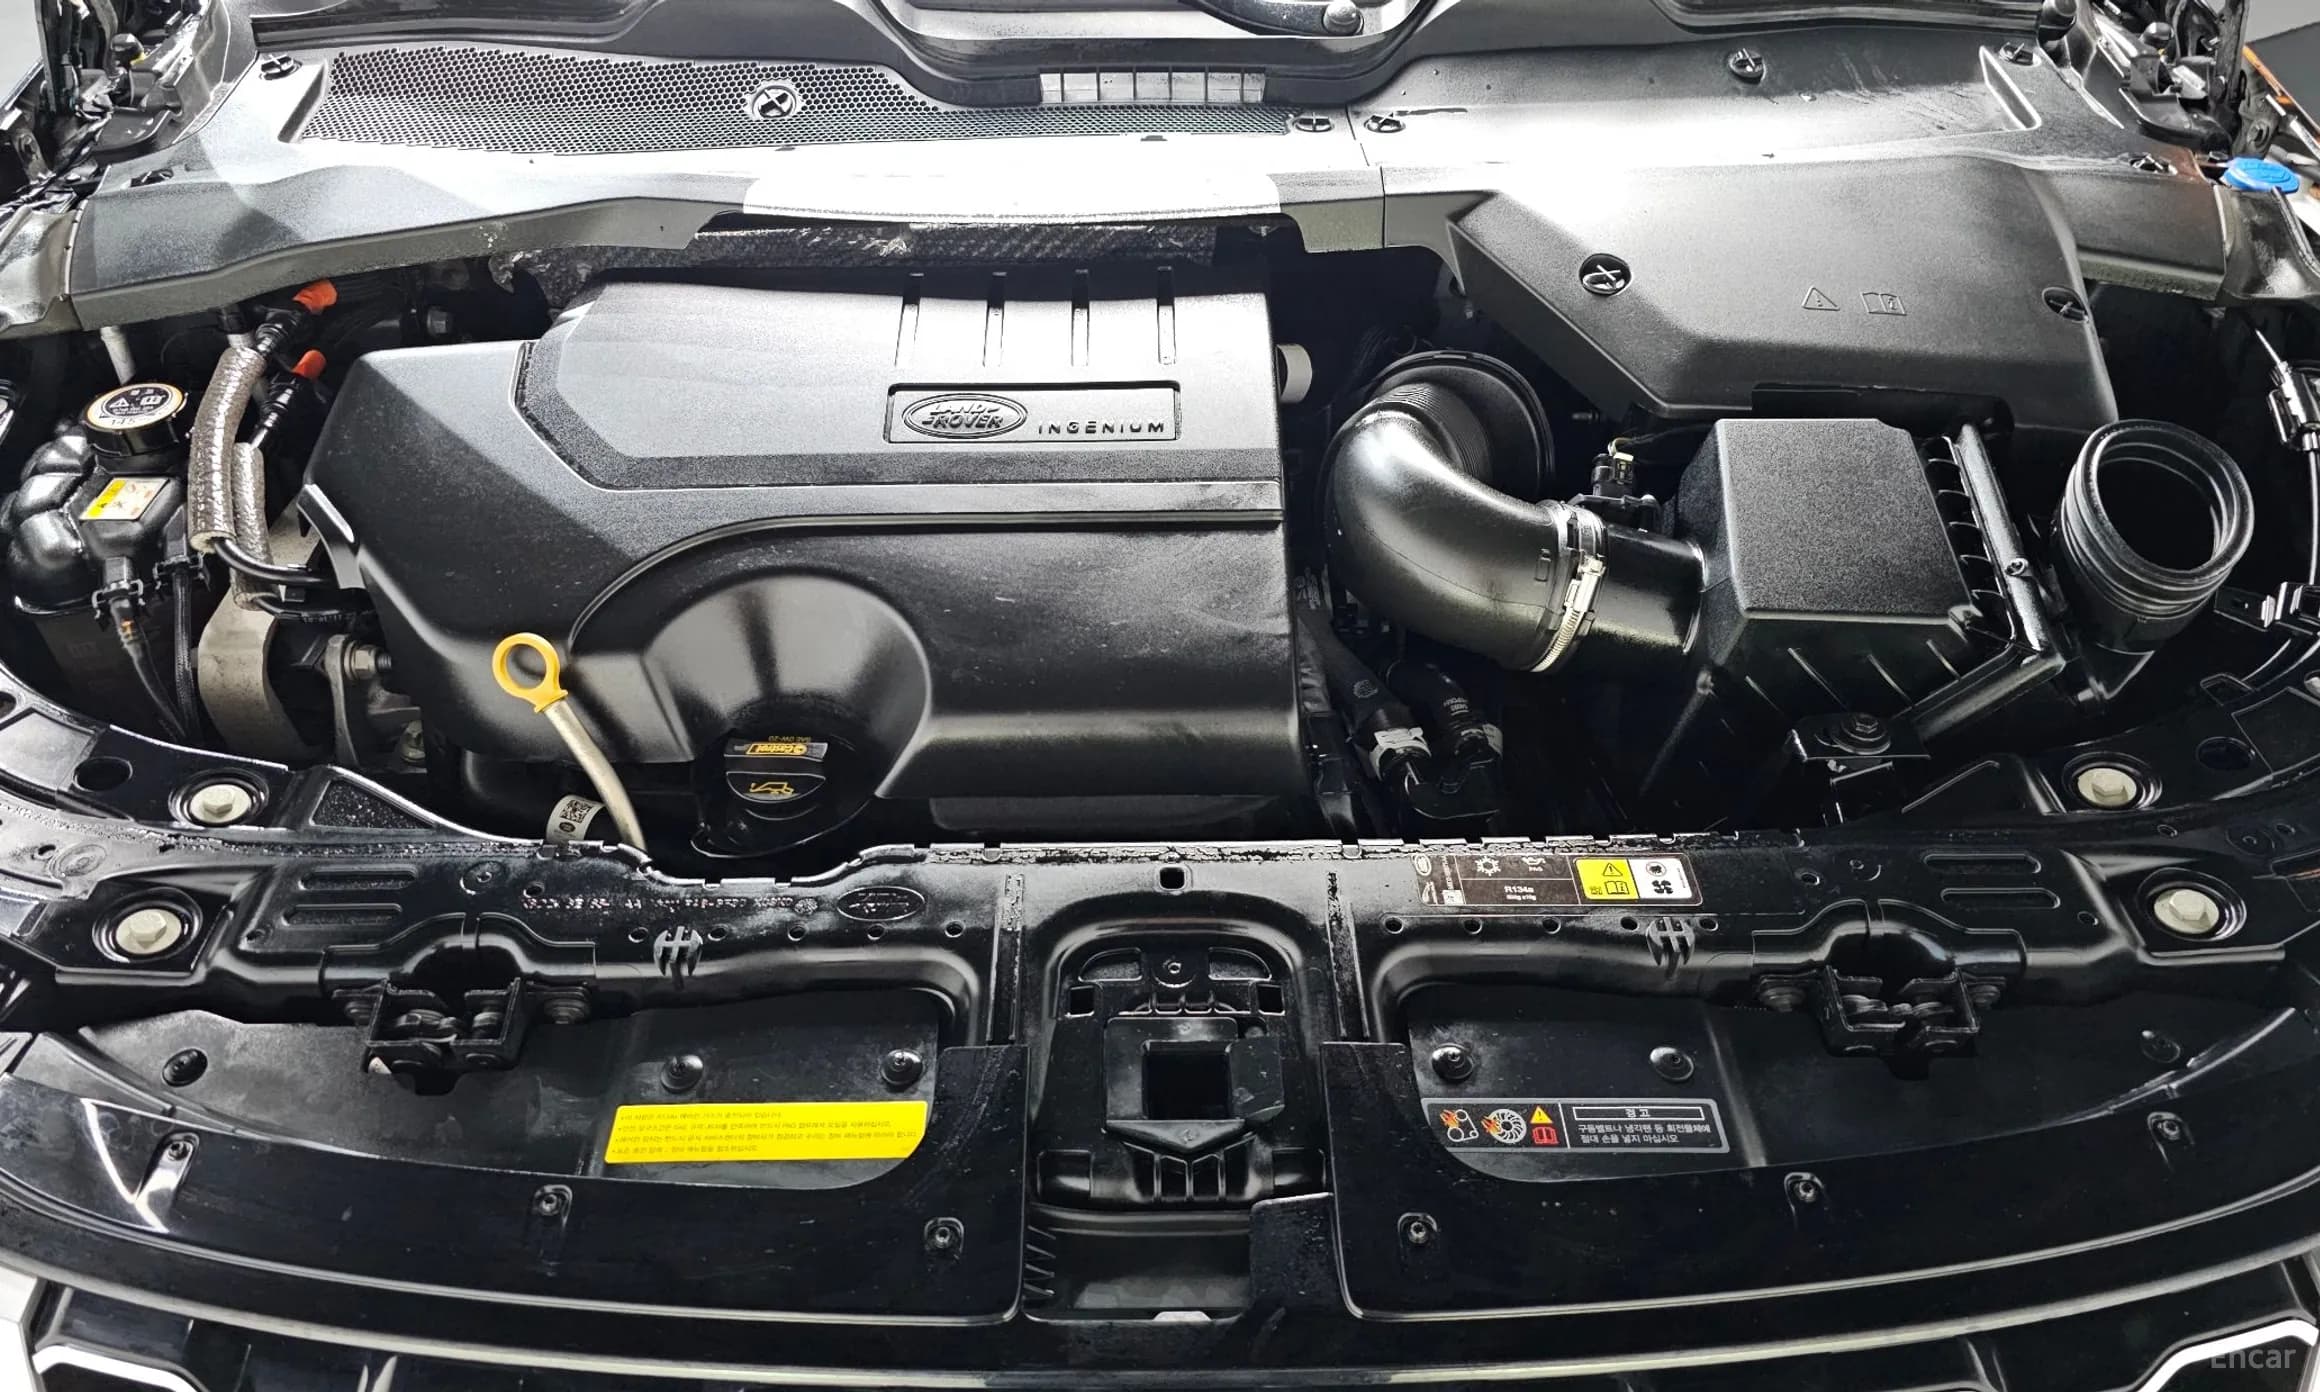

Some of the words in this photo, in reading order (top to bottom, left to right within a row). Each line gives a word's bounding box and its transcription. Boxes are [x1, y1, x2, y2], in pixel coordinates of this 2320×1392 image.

[929, 402, 990, 415] LAND
[931, 415, 1003, 429] ROVER
[1038, 421, 1165, 434] INGENIUM
[1503, 885, 1535, 893] R134a
